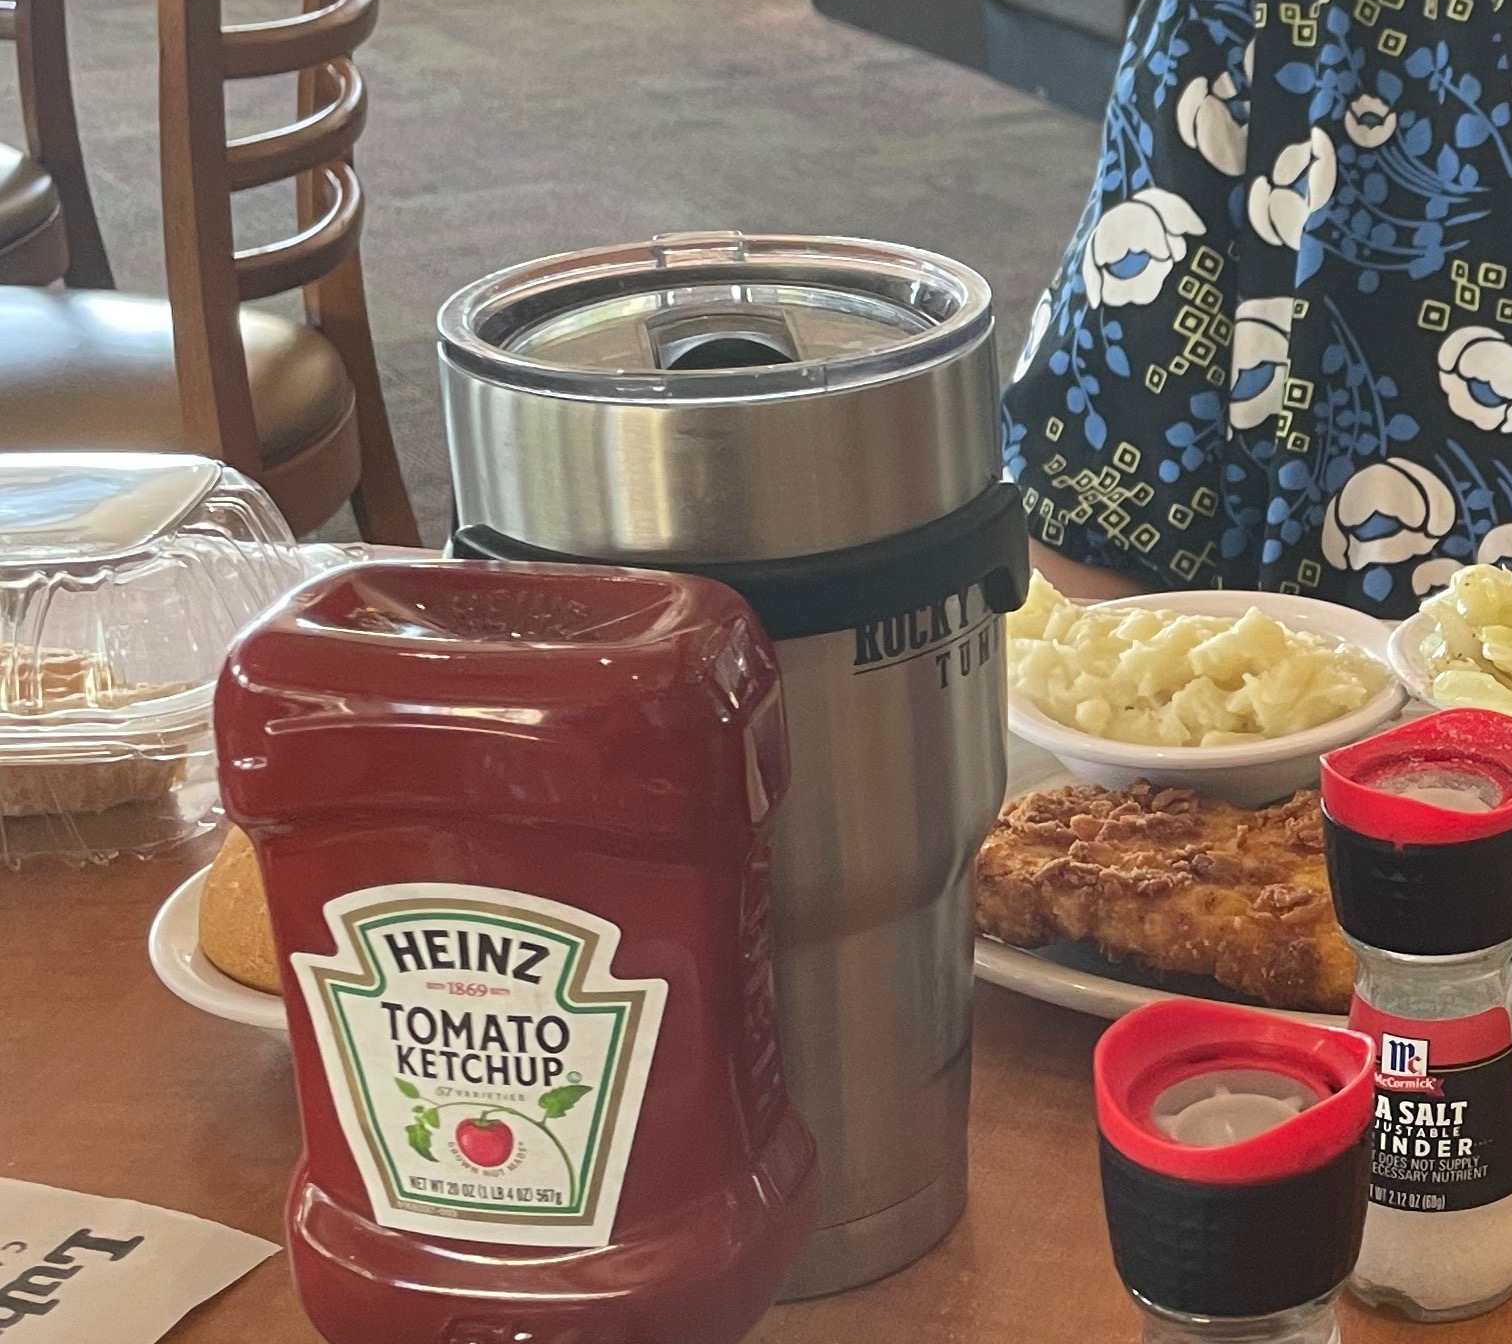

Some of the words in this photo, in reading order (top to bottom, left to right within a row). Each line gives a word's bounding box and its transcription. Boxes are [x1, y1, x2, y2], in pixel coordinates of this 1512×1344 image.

[383, 929, 551, 984] HEINZ
[447, 981, 488, 997] 1869
[380, 1001, 570, 1054] TOMATO
[395, 1044, 564, 1086] KETCHUP
[1398, 1101, 1468, 1127] SALT
[1375, 1121, 1461, 1138] JUSTABLE
[1373, 1132, 1473, 1157] INDER
[1372, 1164, 1429, 1183] ECESSARY
[1431, 1164, 1489, 1183] NUTRIENT
[1378, 1154, 1408, 1168] DOES
[1410, 1158, 1436, 1171] NOT
[1438, 1155, 1481, 1171] SUPPLY
